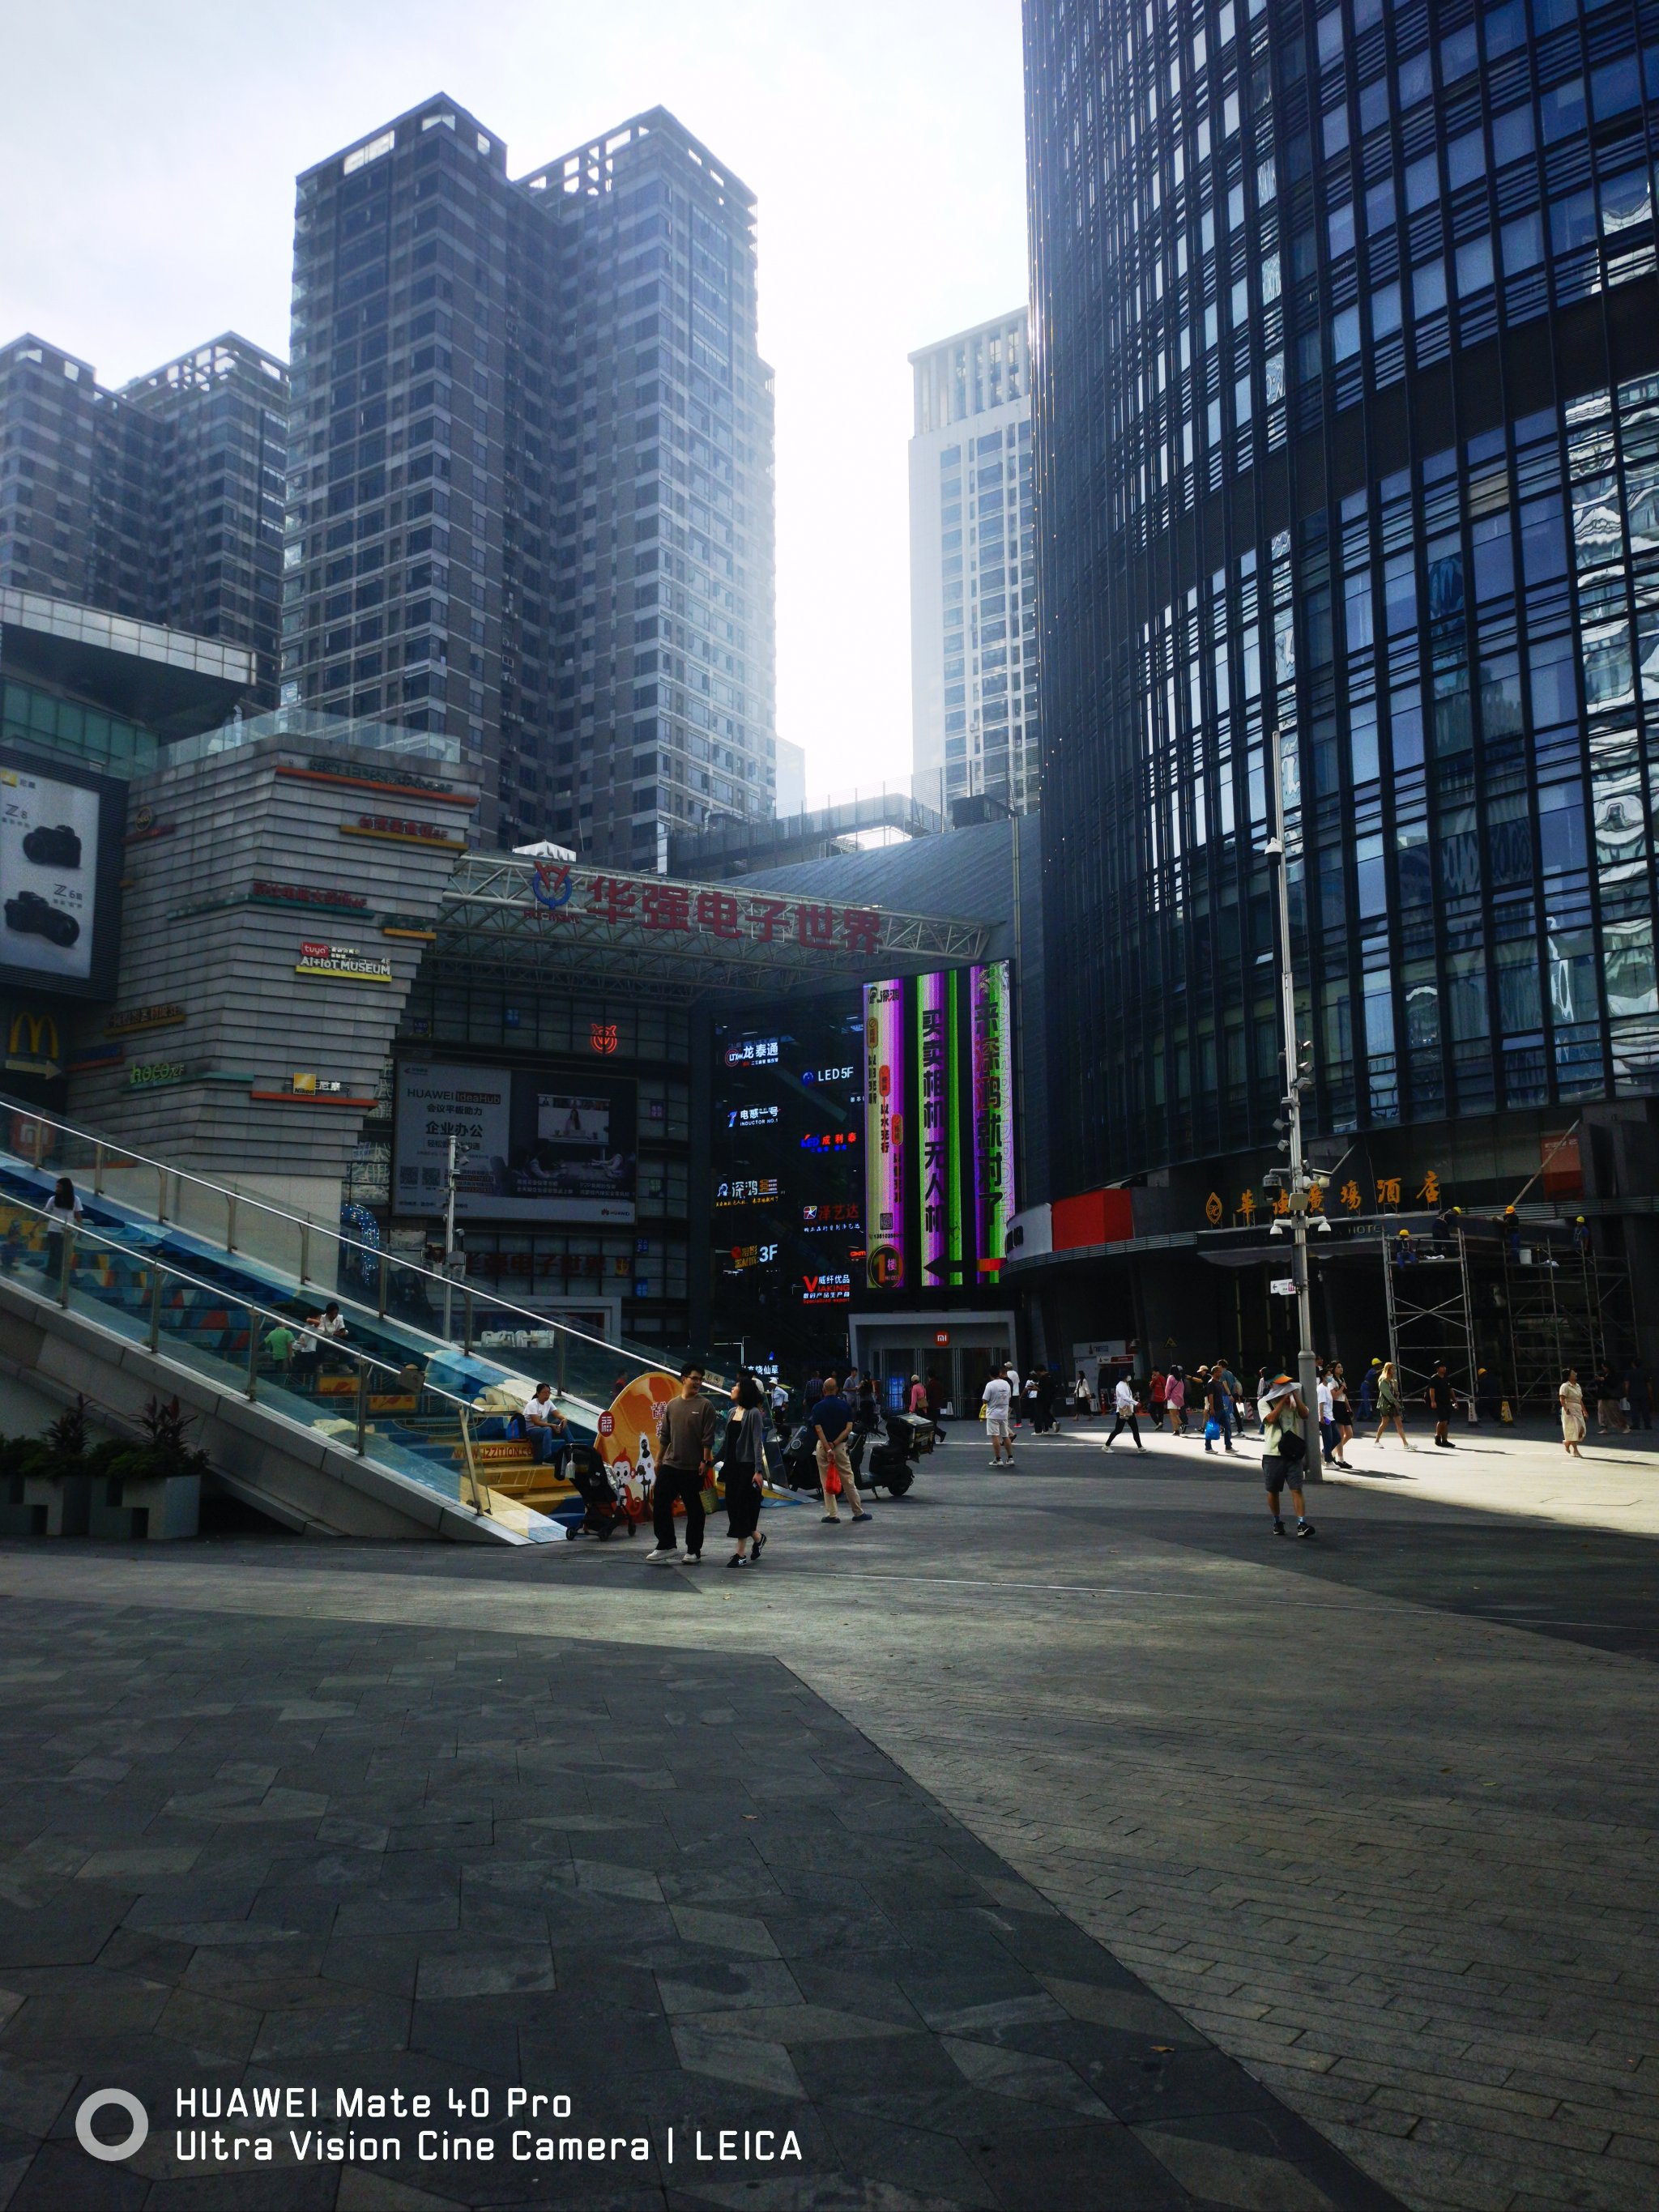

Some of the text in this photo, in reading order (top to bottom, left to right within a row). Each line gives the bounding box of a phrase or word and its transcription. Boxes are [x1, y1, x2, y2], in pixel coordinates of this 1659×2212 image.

[586, 875, 879, 954] 华强电子世界
[304, 947, 327, 956] tuya
[340, 960, 390, 975] MUSEUM
[743, 1042, 778, 1059] 龙泰通
[407, 1089, 500, 1104] HUAWEI IdeaHub
[427, 1104, 482, 1116] 会议平板助力
[740, 1106, 778, 1120] 电感一号
[923, 1009, 947, 1233] 买卖相机 无人机
[426, 1121, 483, 1138] 企业办公
[732, 1180, 758, 1197] 深鸿
[1348, 1225, 1388, 1234] HOTE
[760, 1243, 778, 1263] 3F
[741, 1365, 778, 1375] 烧仙草
